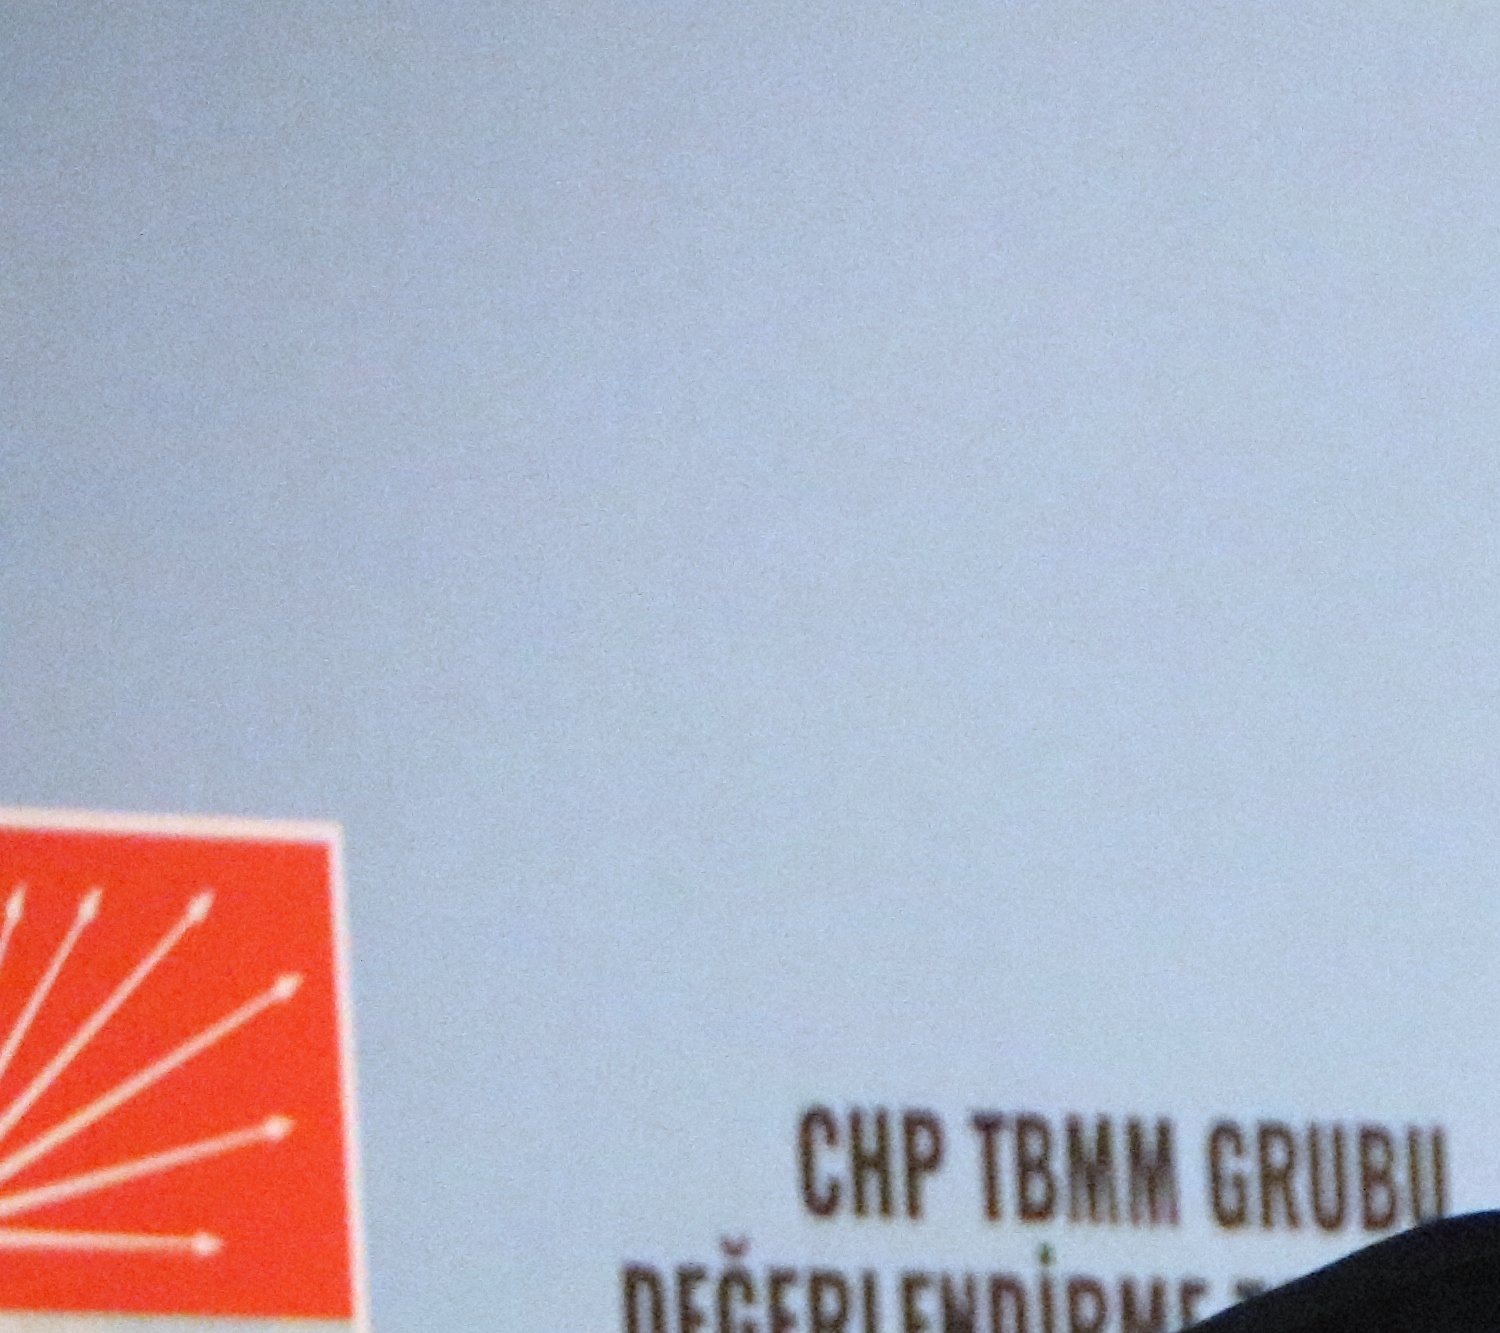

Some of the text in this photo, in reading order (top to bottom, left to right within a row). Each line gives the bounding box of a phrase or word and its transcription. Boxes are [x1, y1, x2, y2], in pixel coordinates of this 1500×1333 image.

[797, 1104, 1450, 1233] CHP TBMM GRUBU
